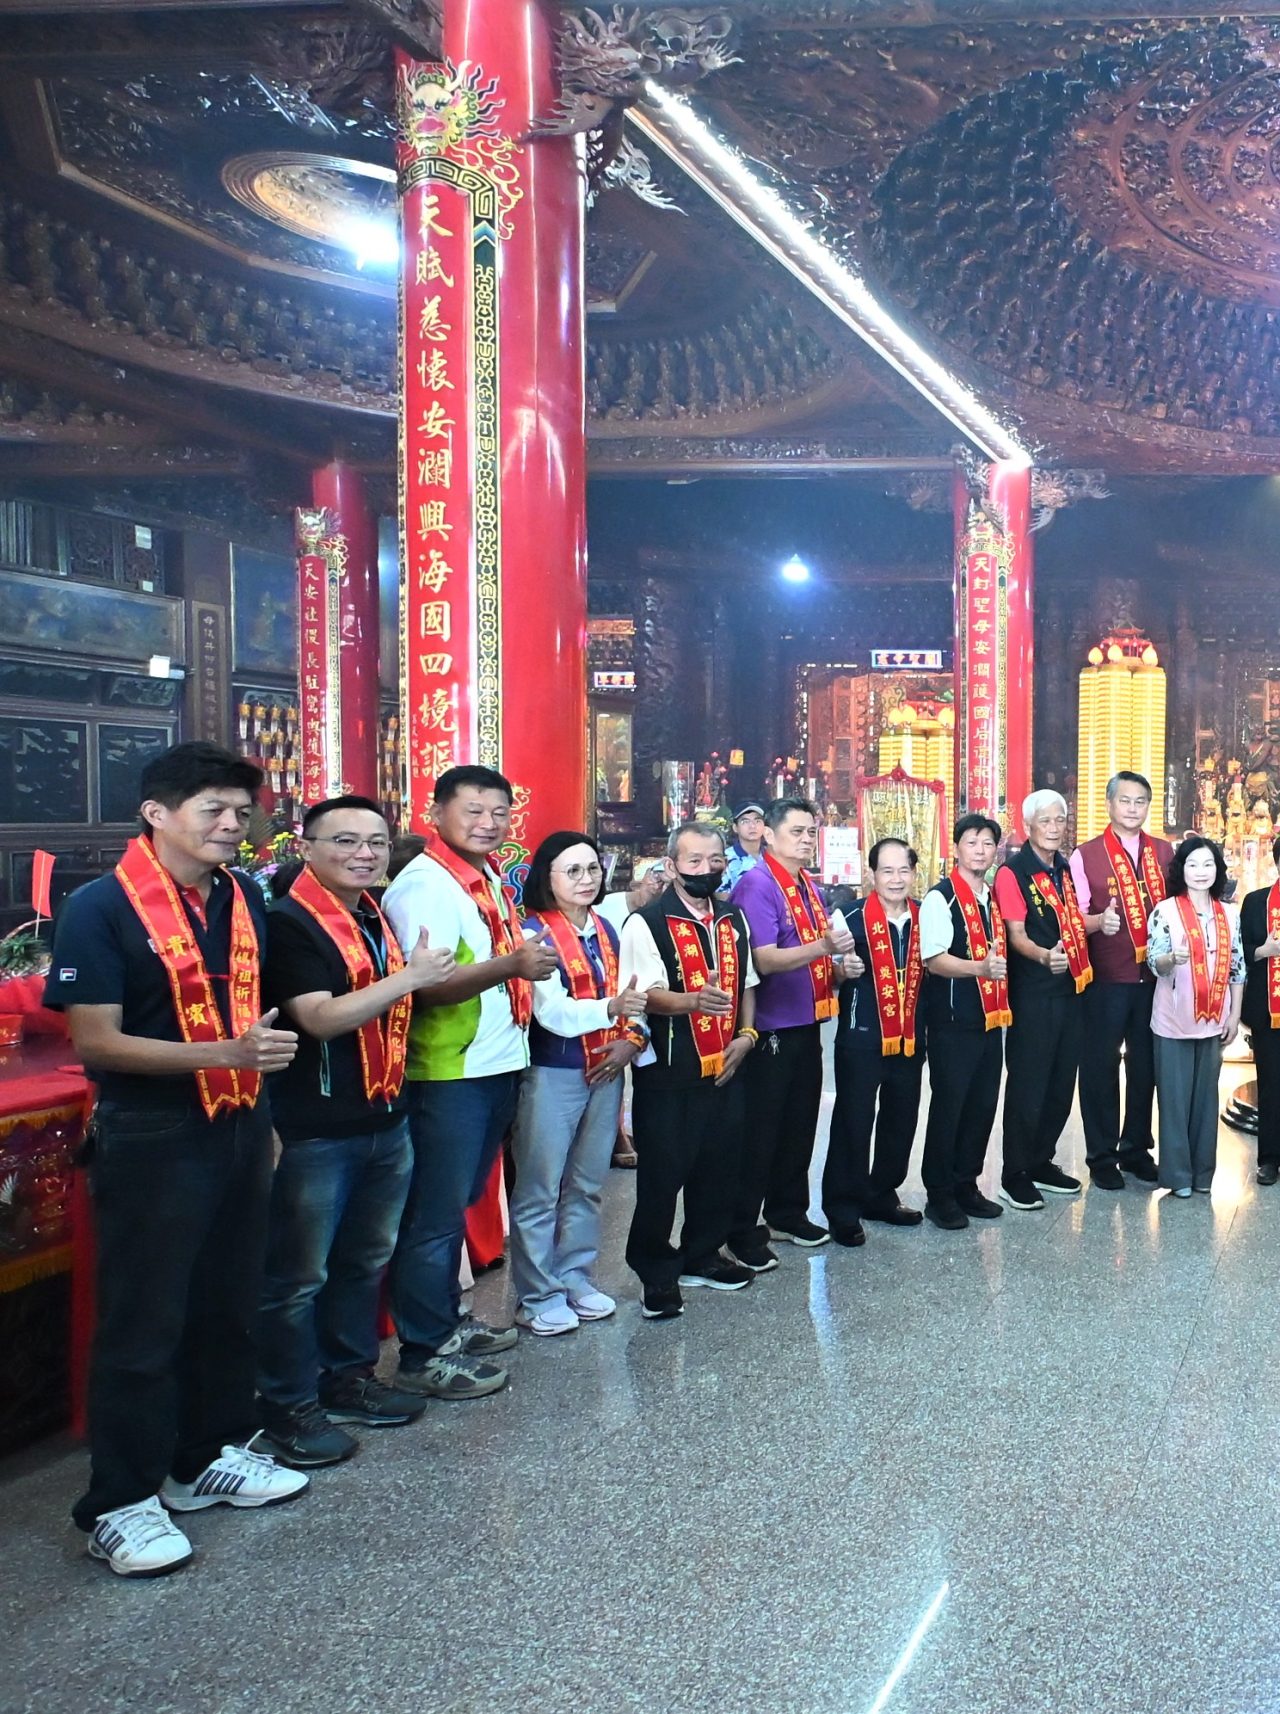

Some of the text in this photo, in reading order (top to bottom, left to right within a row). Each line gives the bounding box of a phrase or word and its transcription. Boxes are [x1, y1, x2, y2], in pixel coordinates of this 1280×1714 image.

[675, 921, 713, 1033] 溪湖福宮
[786, 885, 825, 980] 田中乾宮
[964, 902, 993, 995] 彰化南宮
